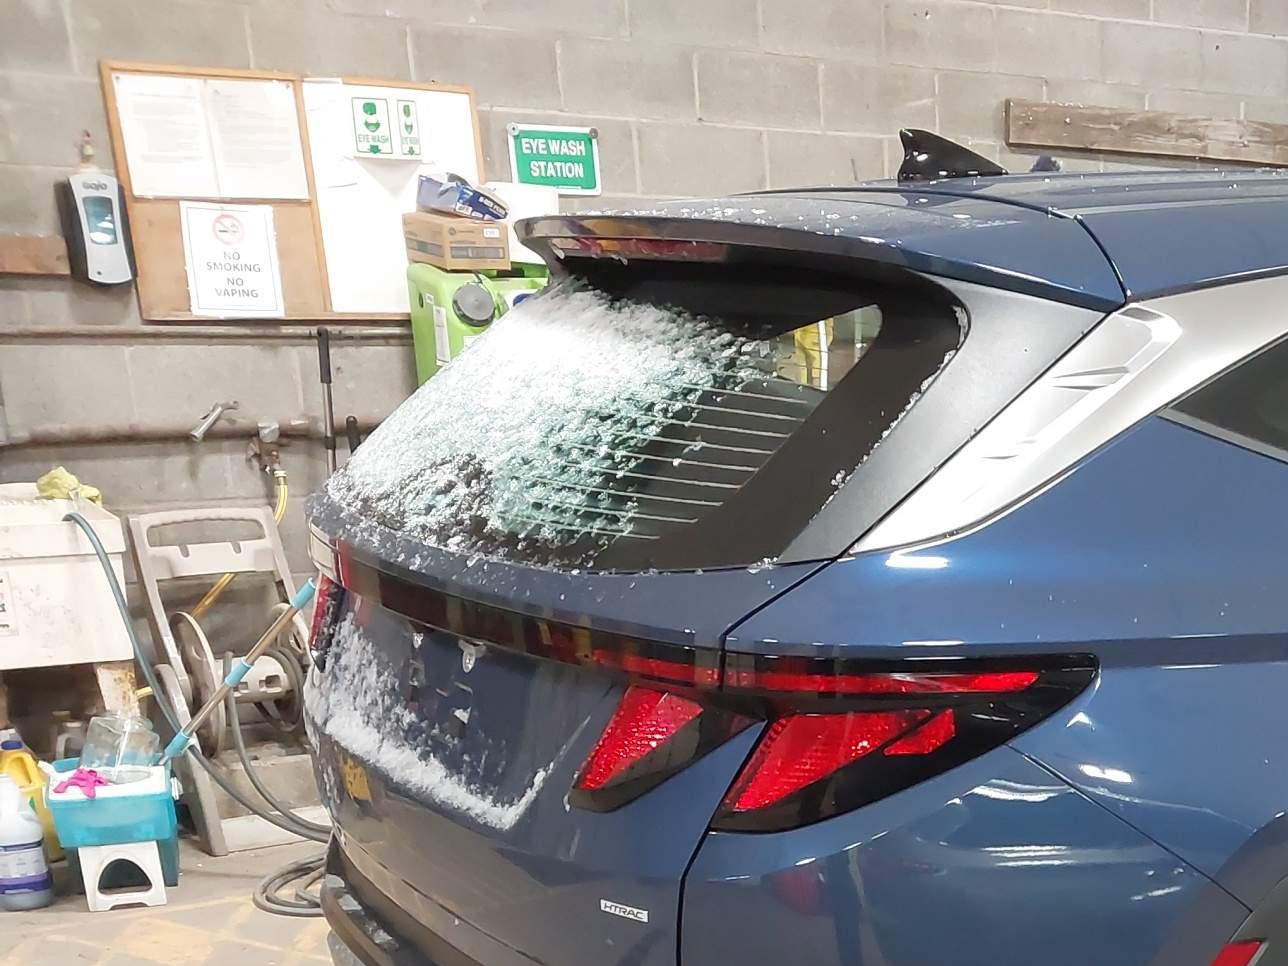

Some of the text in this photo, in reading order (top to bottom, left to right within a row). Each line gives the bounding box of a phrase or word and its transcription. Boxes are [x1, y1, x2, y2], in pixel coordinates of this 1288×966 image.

[521, 138, 586, 156] EYE WASH
[530, 160, 584, 178] STATION
[223, 251, 241, 261] NO
[206, 261, 261, 273] SMOKING
[226, 277, 244, 287] NO
[214, 288, 259, 298] VAPING
[604, 902, 645, 919] HTRAC
